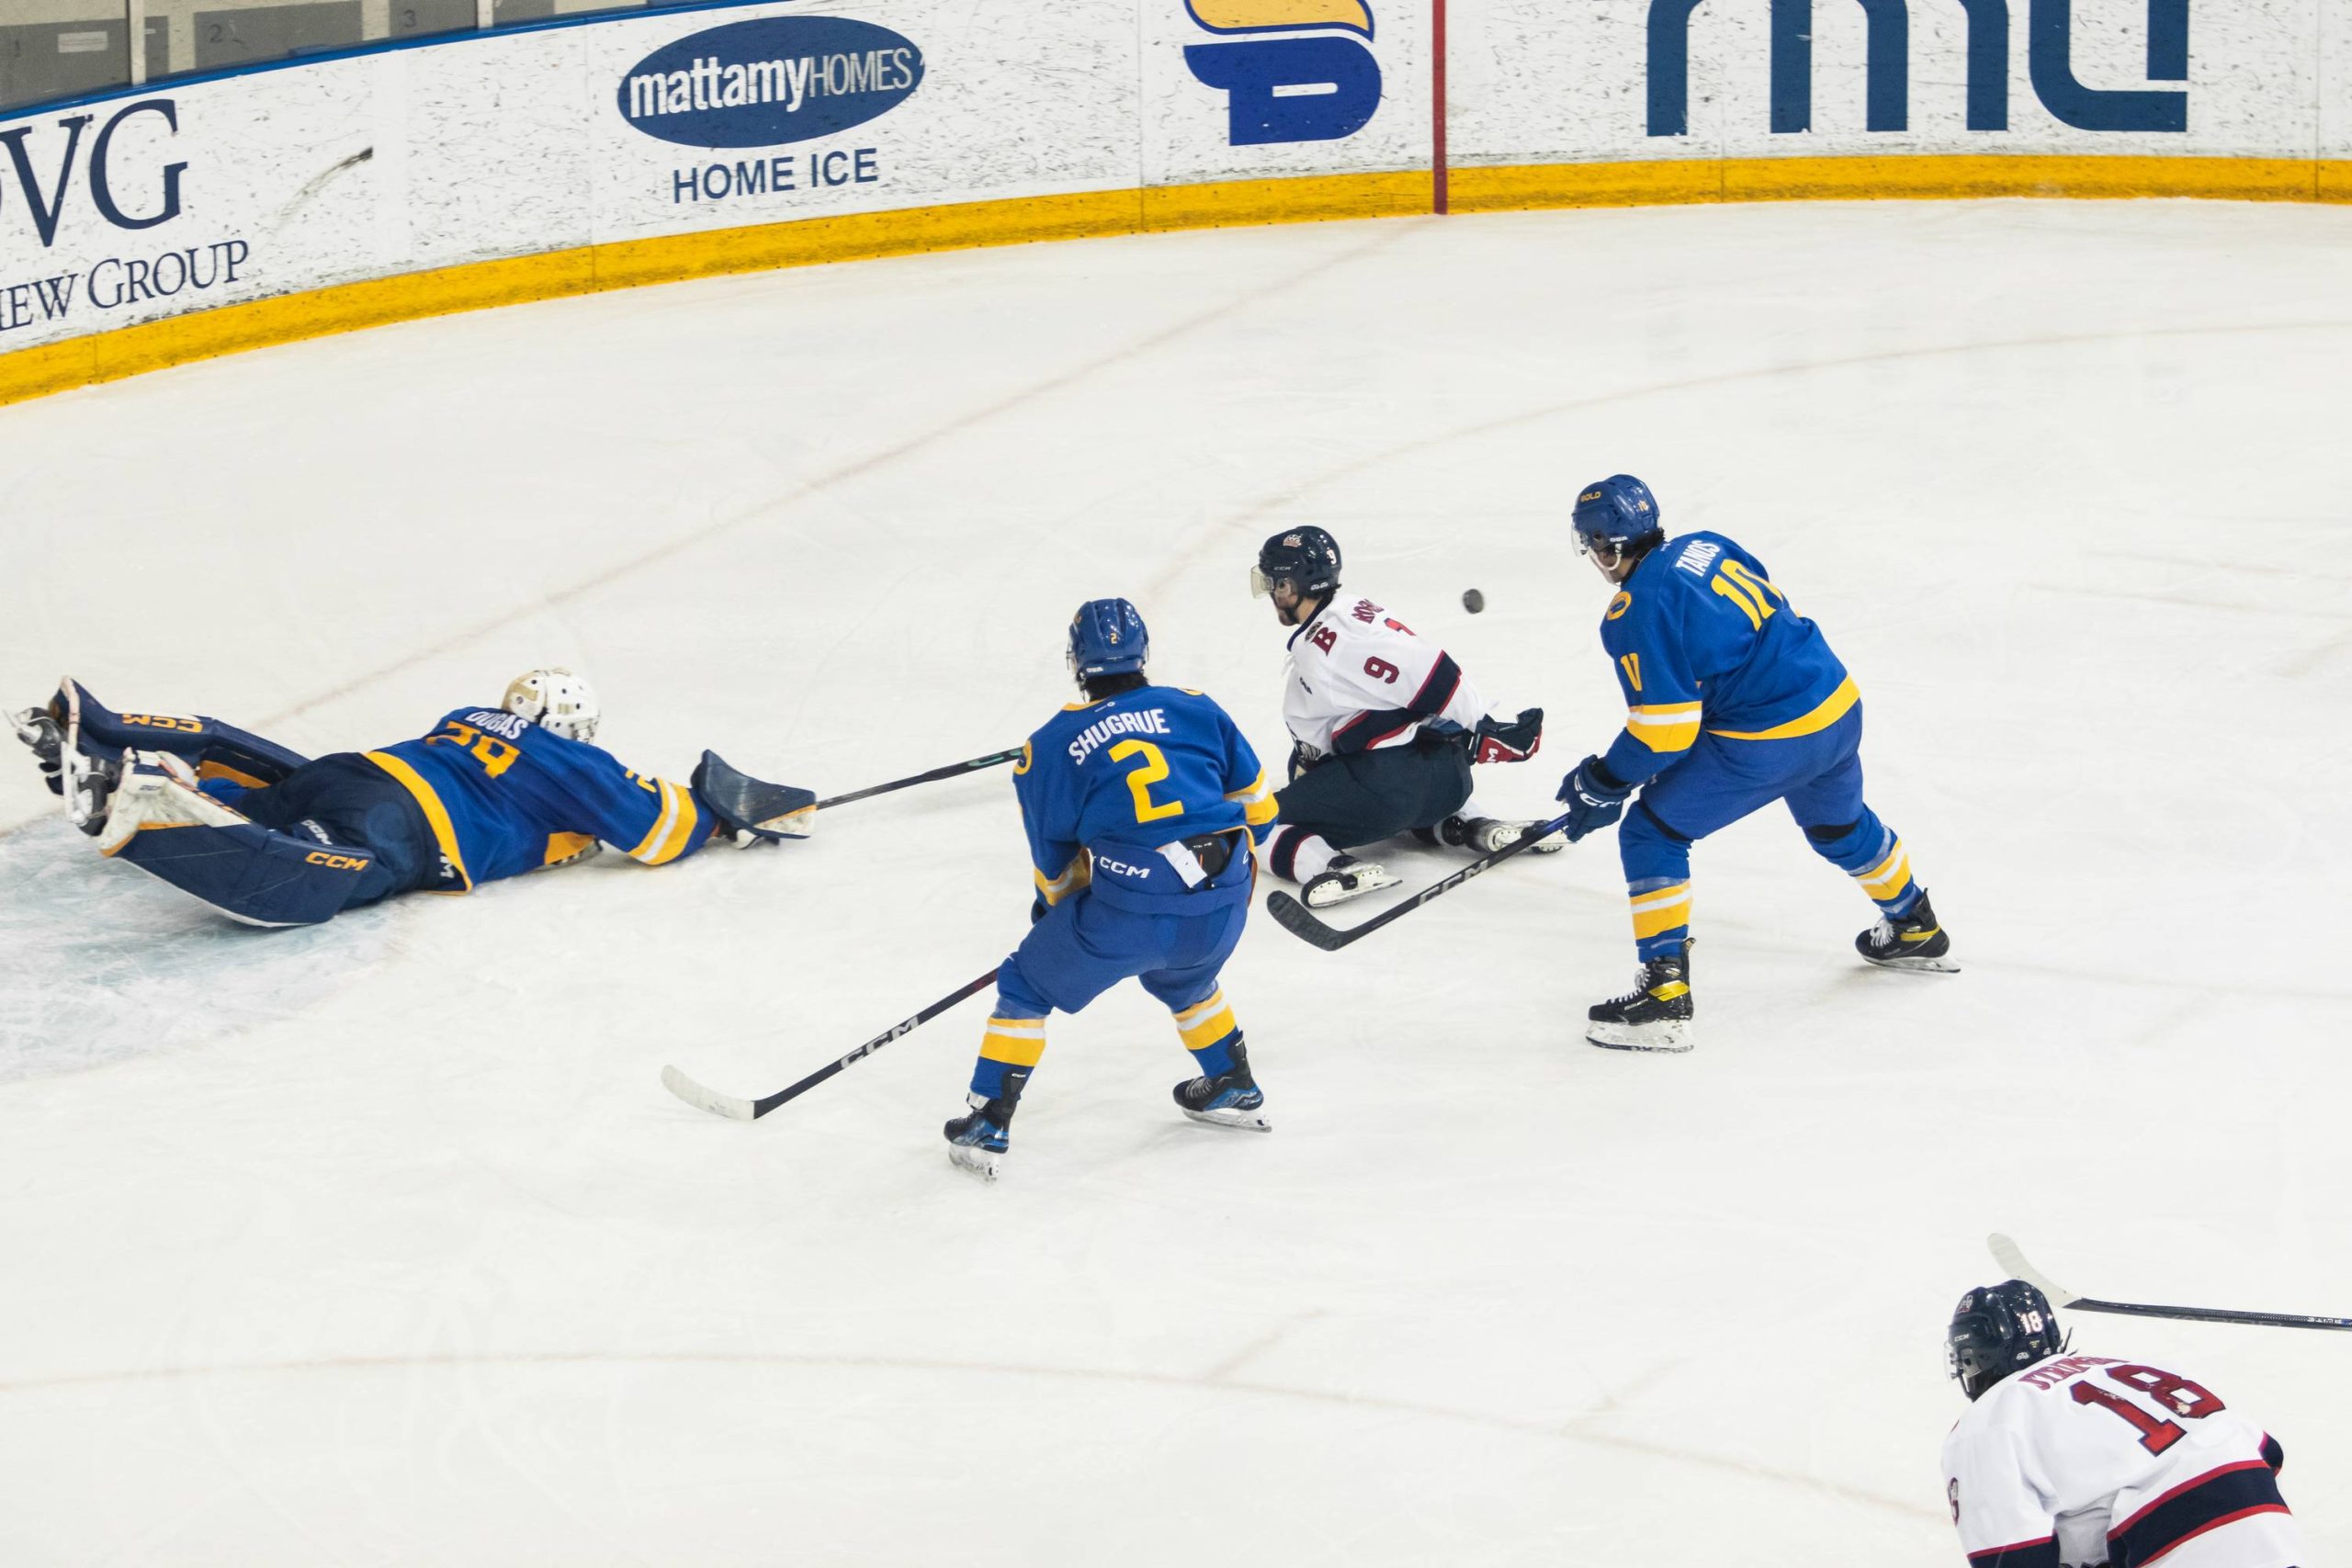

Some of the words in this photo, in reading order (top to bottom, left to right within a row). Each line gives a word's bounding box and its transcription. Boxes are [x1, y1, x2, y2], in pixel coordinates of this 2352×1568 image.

[401, 9, 416, 28] 3
[209, 24, 224, 43] 2
[673, 156, 796, 204] HOME
[811, 147, 878, 187] ICE
[87, 240, 249, 309] GROUP
[1327, 549, 1337, 565] 9
[1711, 558, 1785, 632] 10
[1110, 632, 1118, 645] 2
[1311, 626, 1338, 657] B
[1363, 656, 1400, 684] 9
[121, 714, 203, 734] CCM
[464, 711, 529, 740] DUGAS
[1069, 709, 1170, 765] SHUGRUE
[1108, 739, 1184, 824] 2
[305, 851, 369, 872] CCM
[1099, 855, 1150, 879] CCM
[841, 1014, 919, 1069] CCM
[2019, 1310, 2044, 1335] 18
[2070, 1363, 2226, 1458] 18
